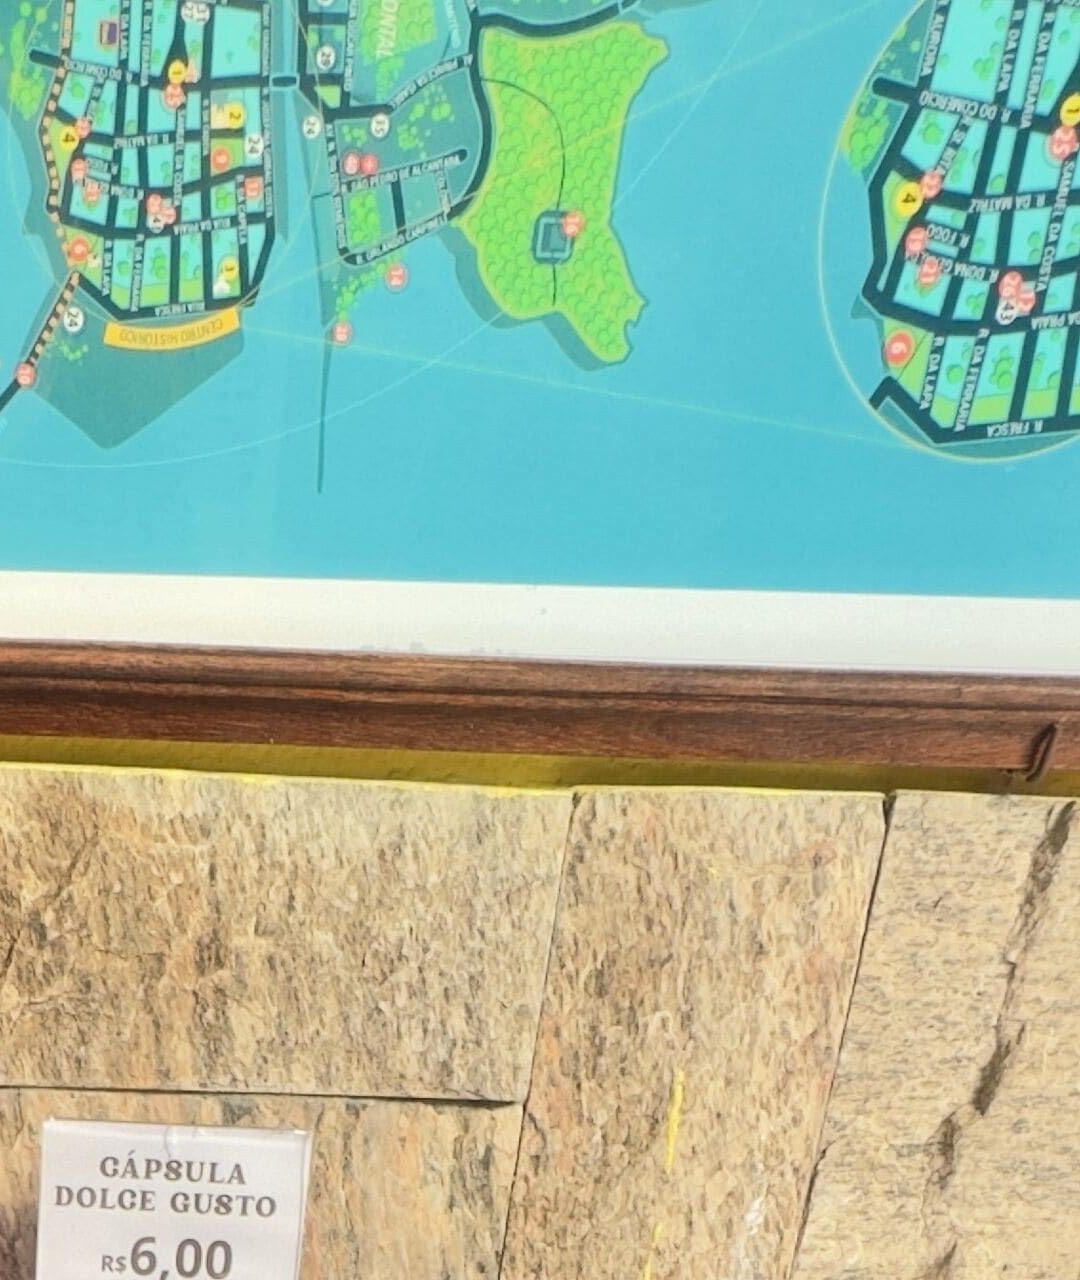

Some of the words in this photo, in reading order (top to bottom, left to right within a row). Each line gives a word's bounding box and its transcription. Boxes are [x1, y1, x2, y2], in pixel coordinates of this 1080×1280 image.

[921, 14, 943, 78] AURORA
[1003, 28, 1021, 53] DA
[1034, 31, 1052, 56] DA
[996, 52, 1014, 93] LAPA
[1019, 56, 1044, 130] FERRARIA
[979, 105, 999, 121] DO
[247, 136, 261, 156] 24
[1014, 194, 1032, 210] DA
[1052, 160, 1077, 223] SAMUEL
[967, 194, 1014, 215] MATRIZ
[925, 224, 959, 247] FOGO
[1034, 245, 1057, 293] COSTA
[67, 310, 79, 328] 24
[1030, 312, 1066, 331] PRAIA
[925, 352, 942, 374] DA
[968, 344, 986, 365] DA
[918, 373, 937, 411] LAPA
[952, 365, 979, 433] FERRARIA
[986, 417, 1031, 438] FRESCA
[100, 1150, 247, 1186] CÁPSULA
[54, 1185, 157, 1212] DOLCE
[170, 1192, 277, 1218] GUSTO
